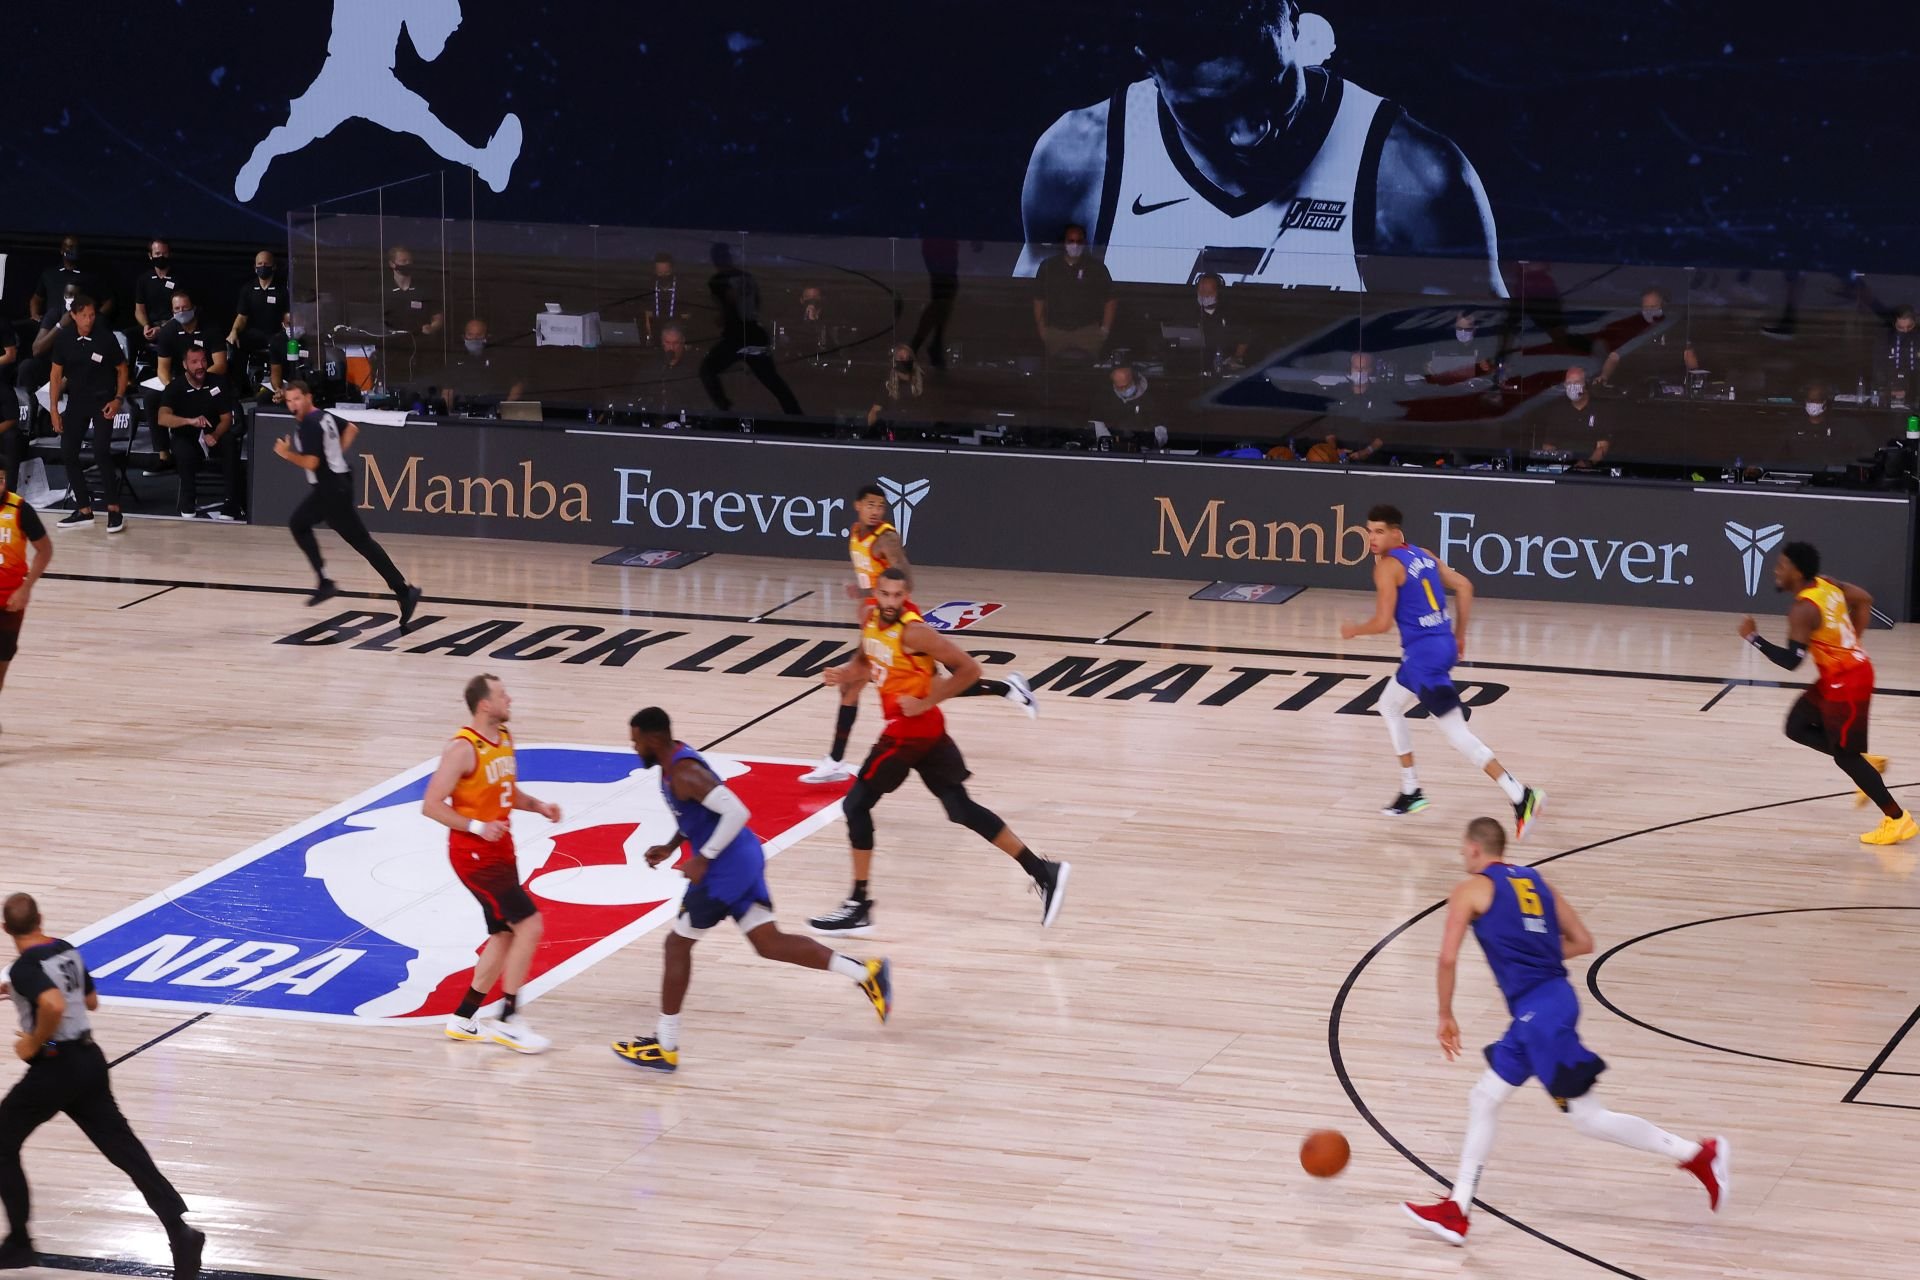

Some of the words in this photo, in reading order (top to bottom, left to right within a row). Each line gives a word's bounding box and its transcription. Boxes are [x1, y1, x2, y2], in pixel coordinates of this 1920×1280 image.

[1304, 215, 1342, 229] FIGHT
[1313, 202, 1328, 211] FOR
[1328, 204, 1342, 212] THE
[357, 453, 592, 523] Mamba
[611, 467, 850, 538] Forever.
[1152, 496, 1404, 567] Mamb
[1434, 511, 1694, 586] Forever.
[272, 610, 691, 667] BLACK
[499, 781, 513, 808] 2
[89, 933, 368, 996] NBA
